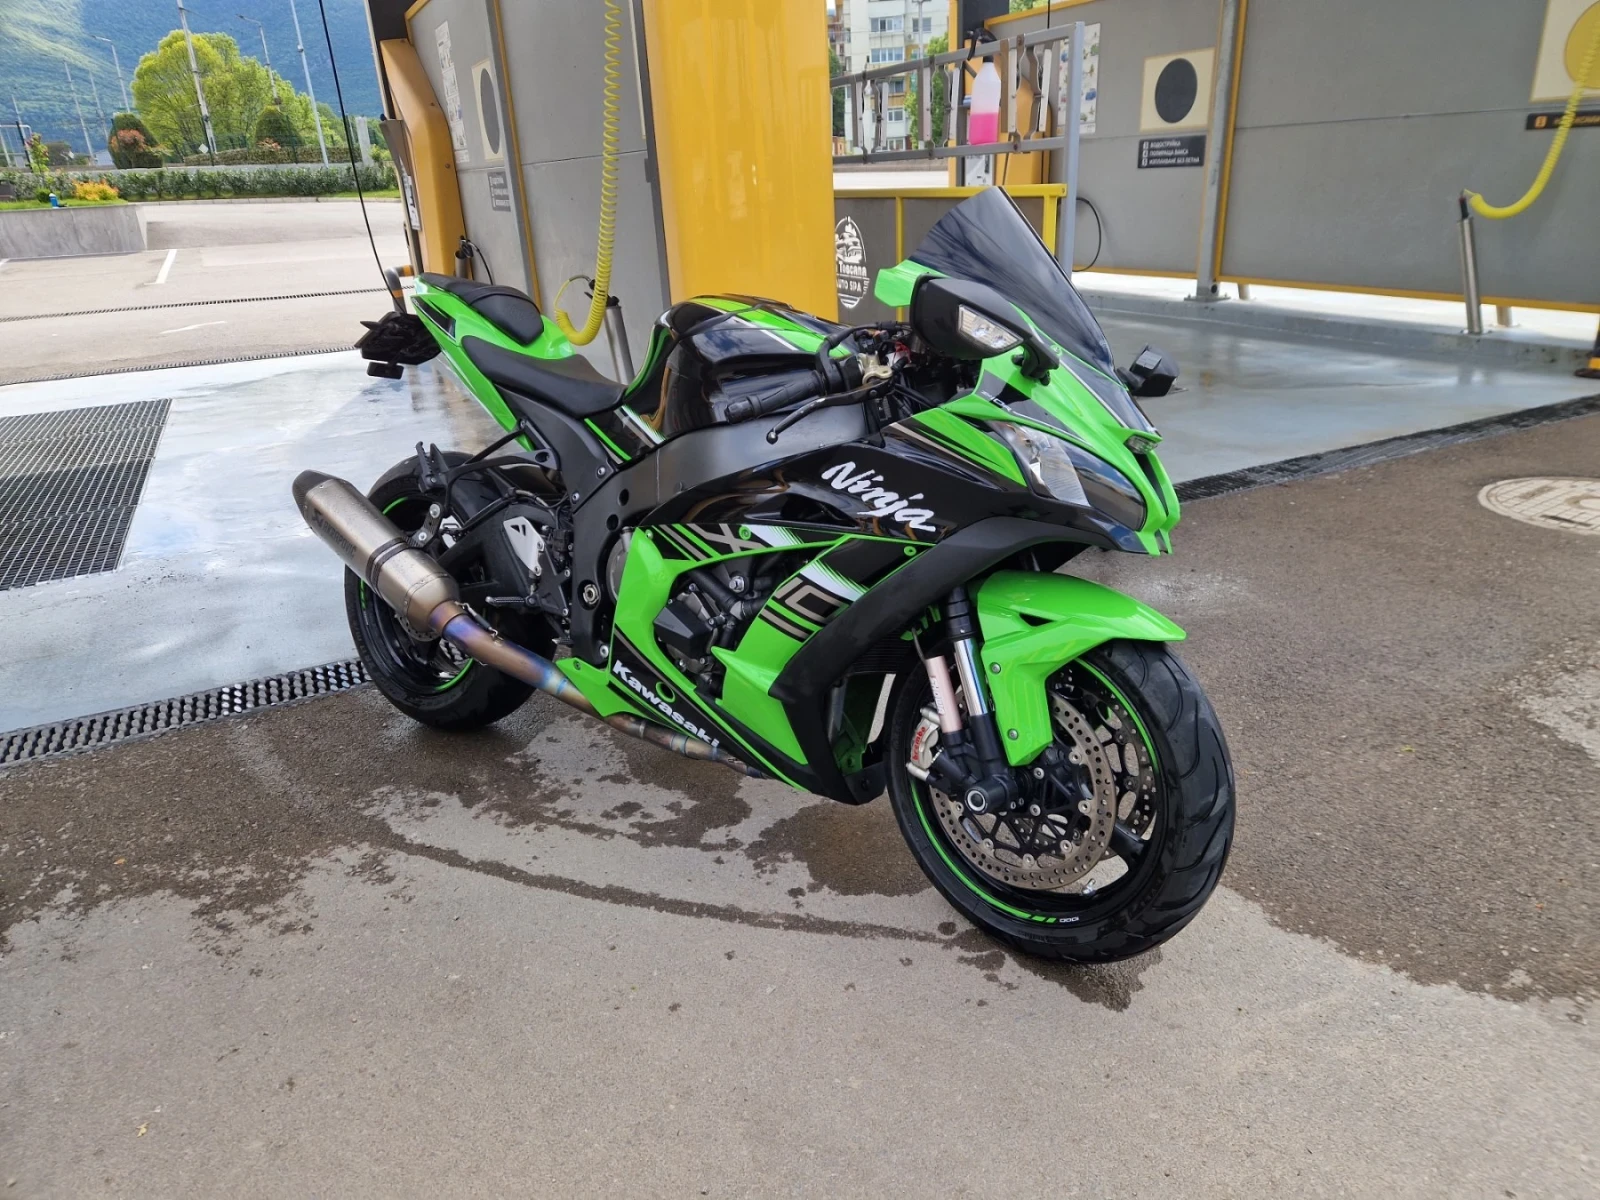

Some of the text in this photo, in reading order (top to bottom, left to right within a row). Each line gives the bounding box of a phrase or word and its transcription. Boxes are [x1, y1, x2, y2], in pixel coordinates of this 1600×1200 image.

[821, 461, 936, 532] Ninja
[613, 660, 719, 747] Kawasaki
[912, 726, 926, 761] brembo
